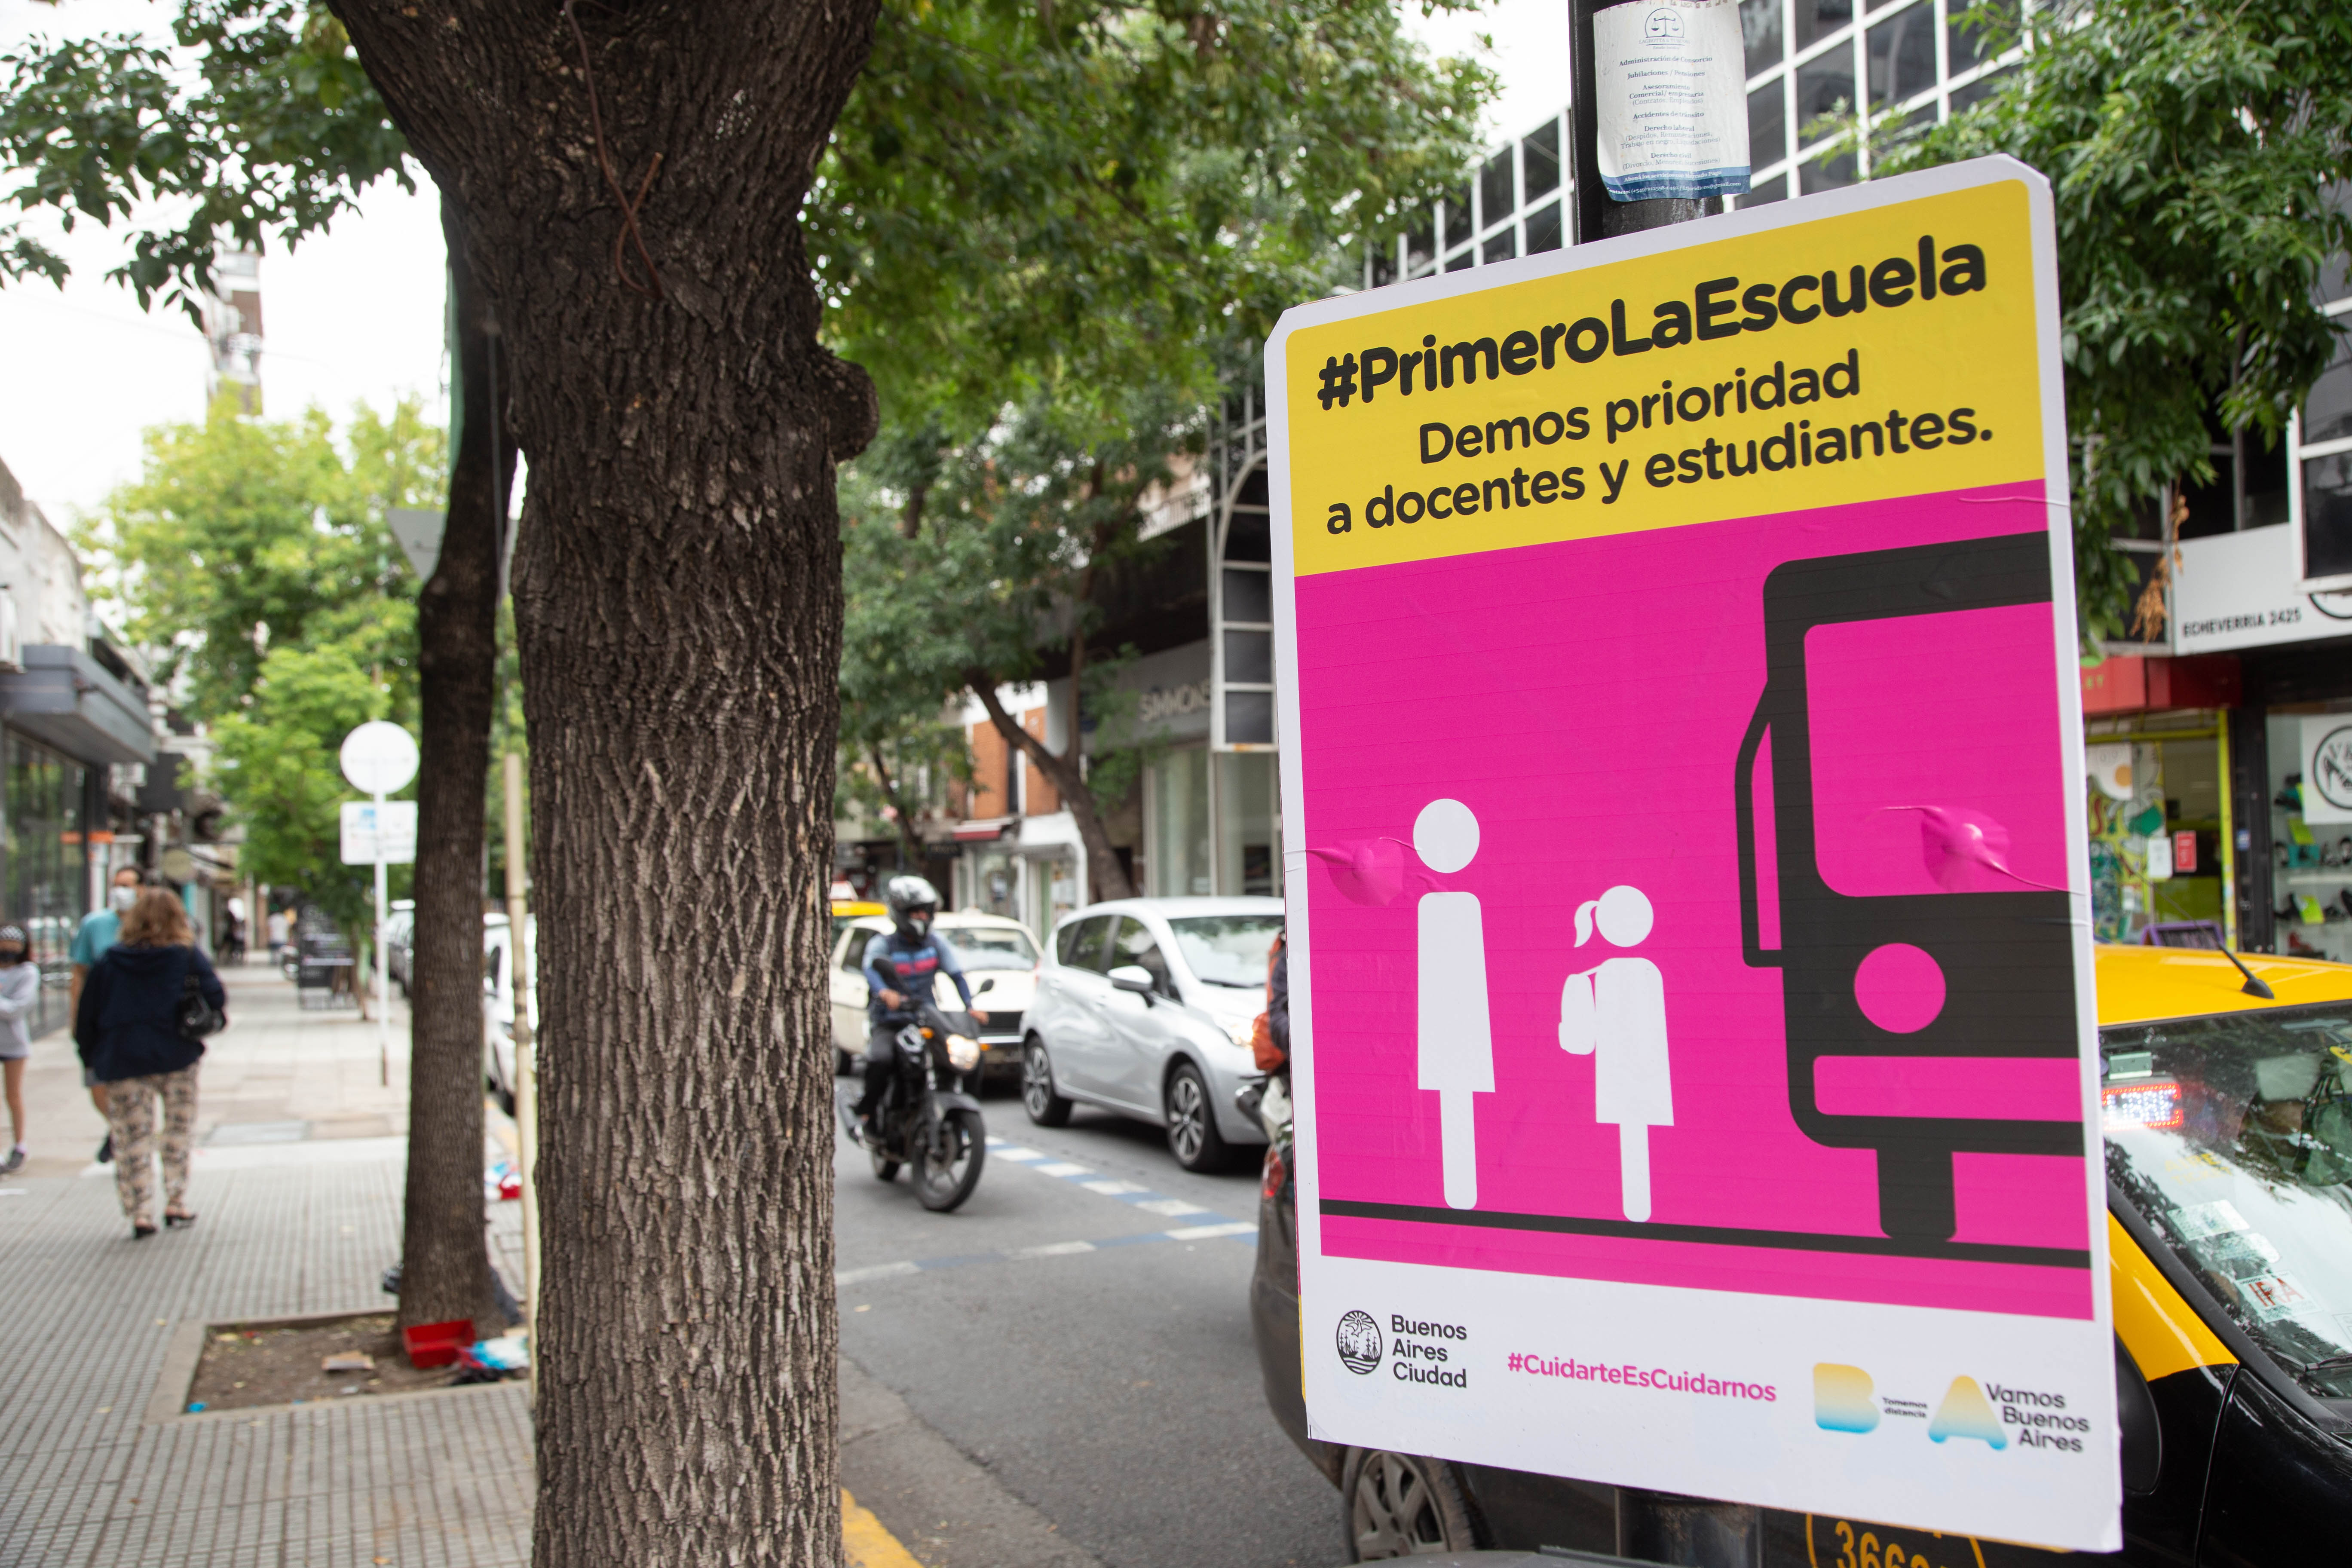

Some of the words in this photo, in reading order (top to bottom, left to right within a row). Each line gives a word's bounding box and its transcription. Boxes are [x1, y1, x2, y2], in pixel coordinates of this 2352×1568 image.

[1619, 55, 1671, 67] Administración
[1628, 70, 1668, 79] Jubilaciones
[1620, 140, 1644, 149] Trabajo
[1317, 235, 1987, 411] #PrimeroLaEscuela
[1419, 406, 1590, 465] Demos
[1605, 348, 1860, 444] prioridad
[1326, 502, 1352, 535] a
[1365, 466, 1586, 529] docentes
[1599, 459, 1629, 505] y
[1645, 407, 1993, 488] estudiantes.
[2183, 612, 2266, 638] ECHEVERRIA
[2269, 606, 2303, 626] 2425
[1391, 1314, 1467, 1340] Buenos
[1392, 1338, 1448, 1362] Aires
[1393, 1362, 1467, 1389] Ciudad
[1507, 1352, 1777, 1402] #CuidarteEsCuidarnos
[1883, 1396, 1928, 1409] Tomemos
[1985, 1382, 2066, 1409] Vamos
[1884, 1407, 1927, 1419] distancia
[2002, 1406, 2090, 1433] Buenos
[2018, 1427, 2084, 1453] Aires
